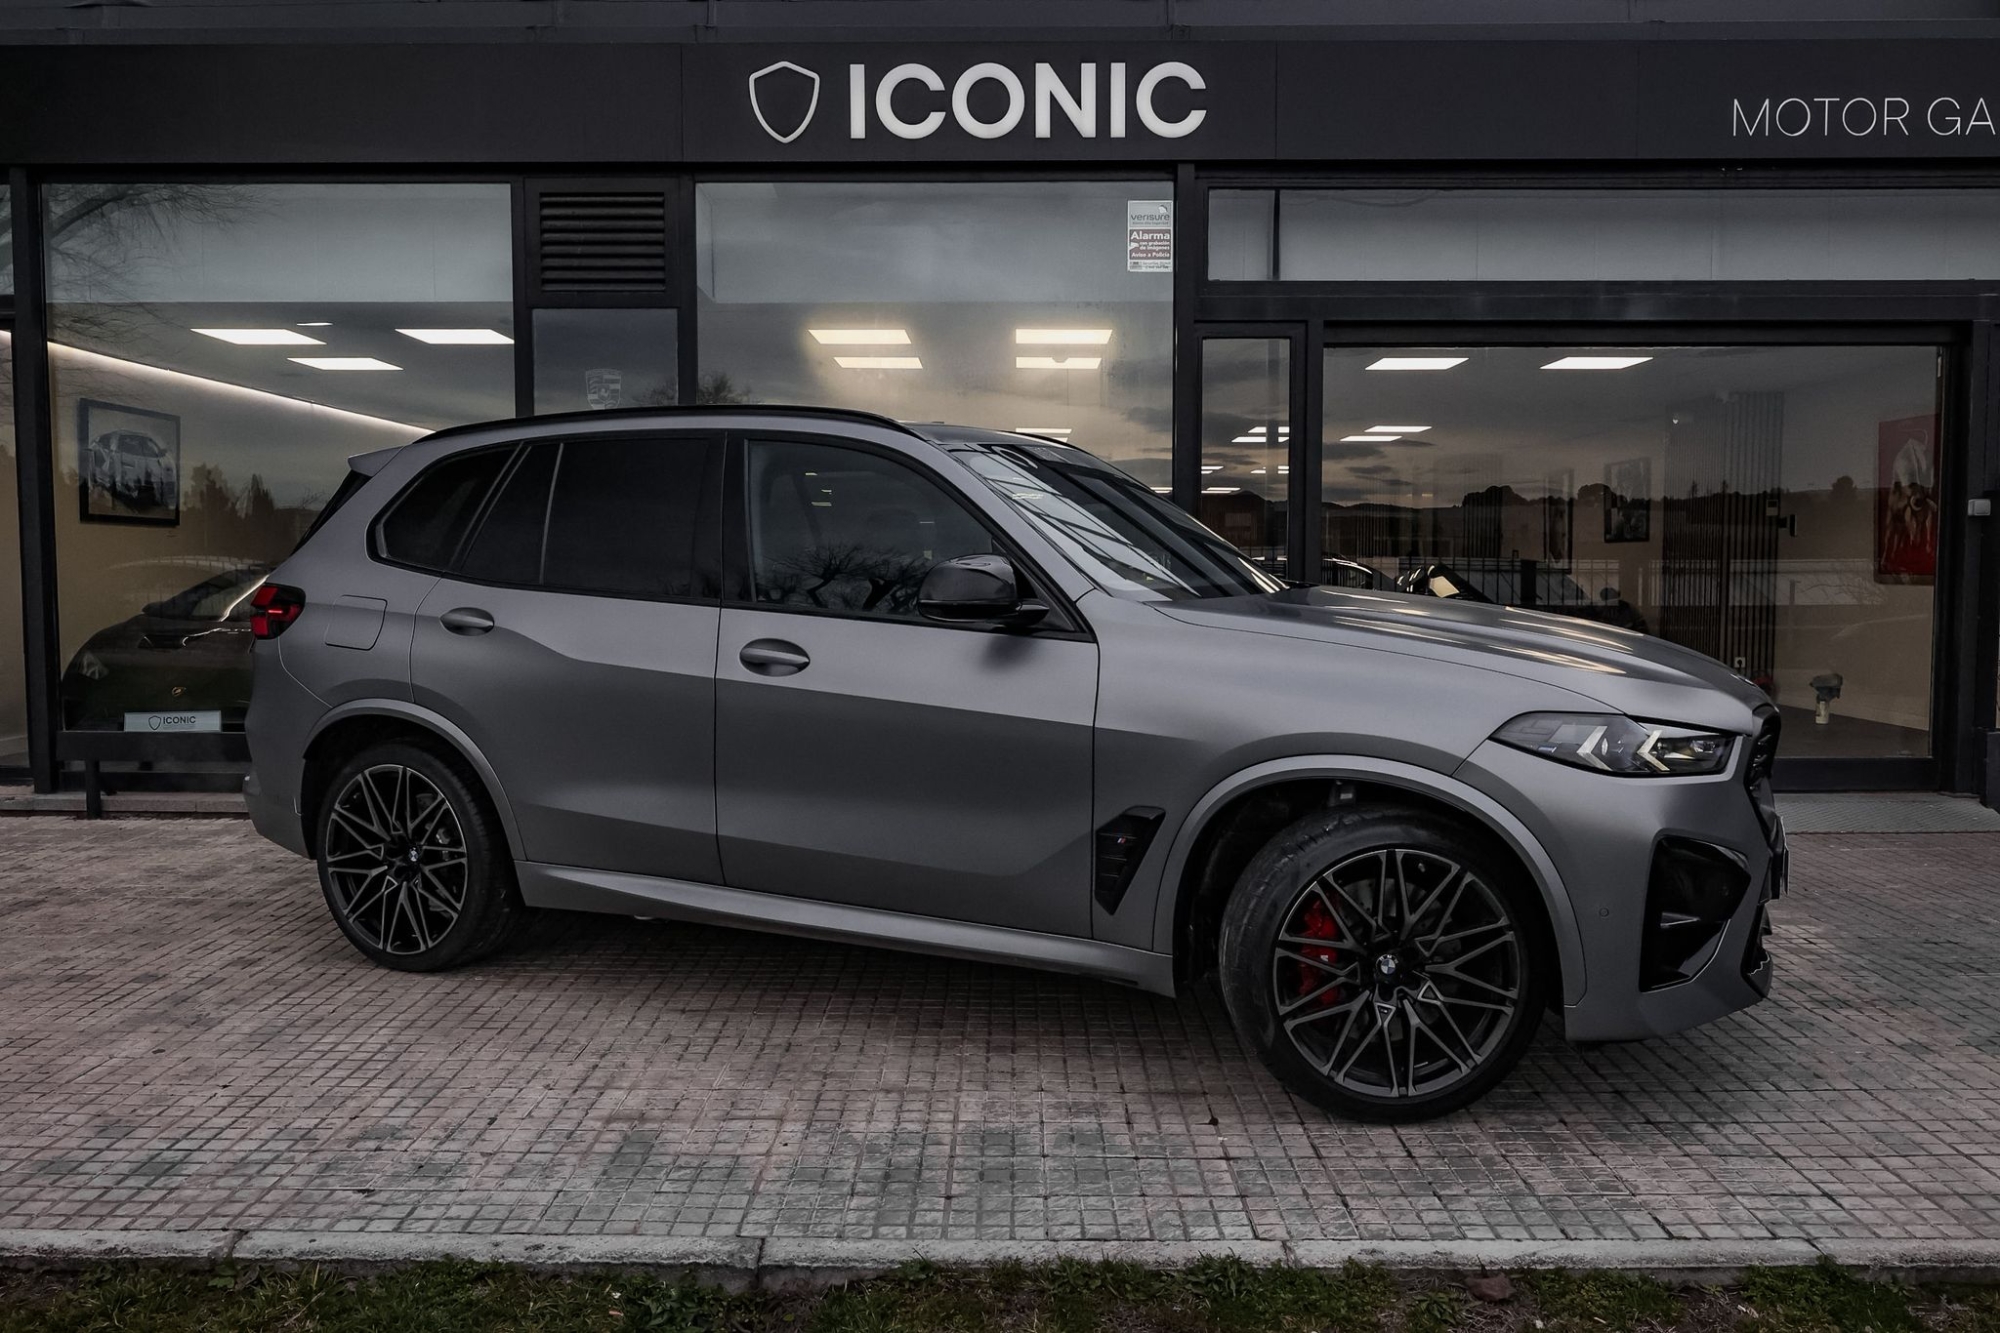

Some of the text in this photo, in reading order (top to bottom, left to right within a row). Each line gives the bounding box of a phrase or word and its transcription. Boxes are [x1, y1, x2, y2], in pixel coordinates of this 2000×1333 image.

[849, 62, 1207, 139] ICONIC
[1732, 97, 1996, 137] MOTOR GA
[1130, 231, 1170, 240] Alarma
[163, 716, 196, 725] ICONIC
